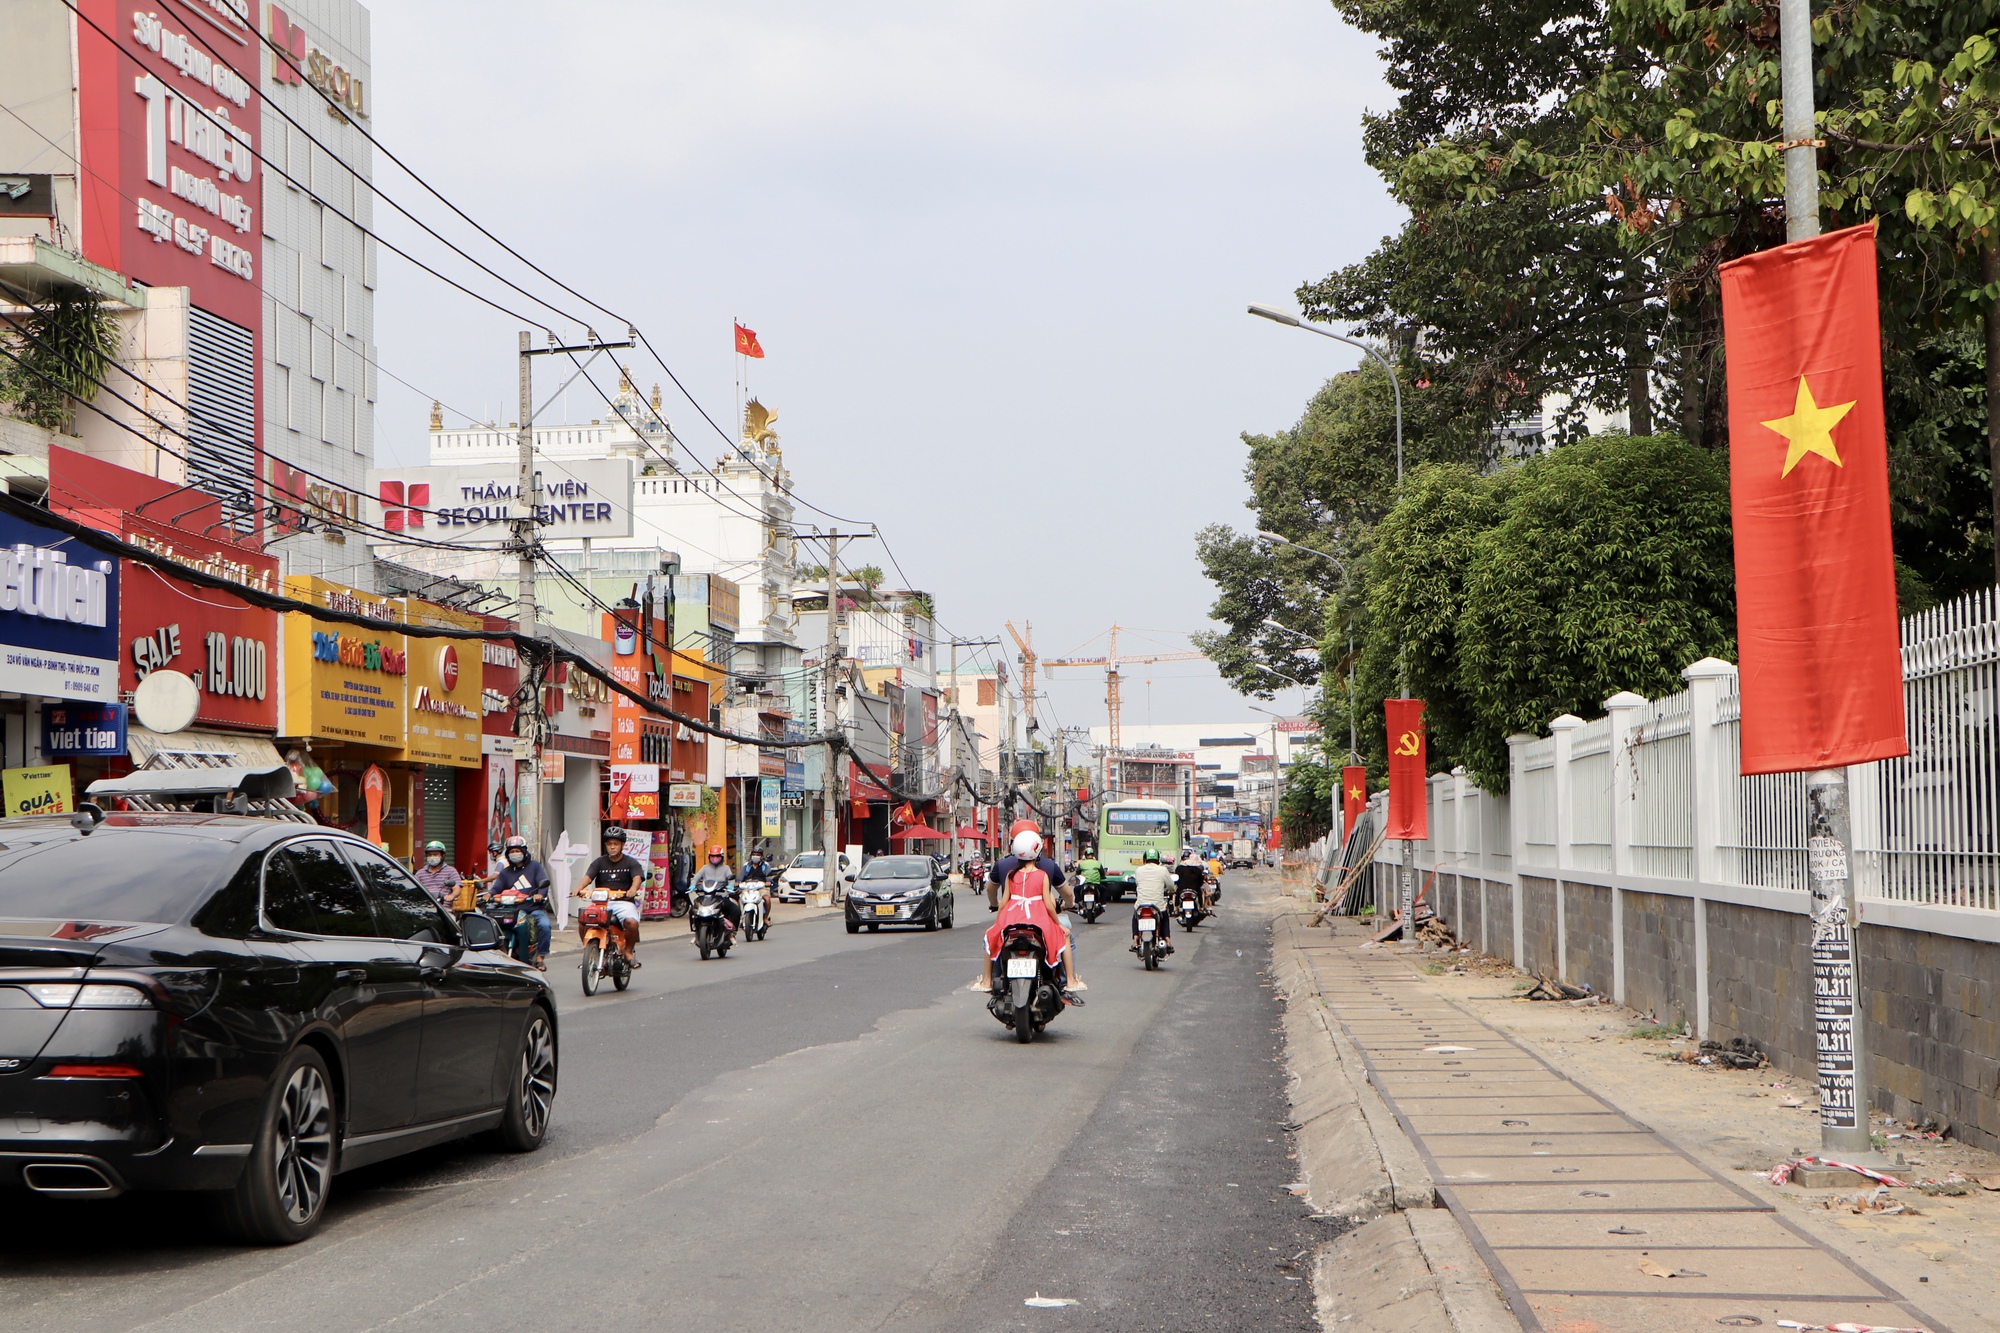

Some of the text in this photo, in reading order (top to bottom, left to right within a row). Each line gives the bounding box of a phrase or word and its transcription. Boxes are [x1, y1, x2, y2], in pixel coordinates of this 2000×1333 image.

[161, 28, 212, 88] MỆNH
[308, 47, 370, 120] SEOUL
[134, 72, 252, 188] 1 TRIỆU
[171, 165, 253, 234] NGƯỜI VIỆT
[137, 197, 175, 243] ĐẠT
[211, 235, 253, 281] IELTS
[460, 481, 512, 500] THẨM
[547, 479, 588, 500] VIỆN
[533, 502, 612, 524] ENTER
[131, 623, 182, 683] SALE
[204, 631, 267, 702] 19.000
[312, 630, 407, 676] Thế Giới Đồ Chơi
[50, 727, 117, 750] viet tien
[19, 790, 55, 813] QUÀ
[1824, 869, 1845, 878] 7878
